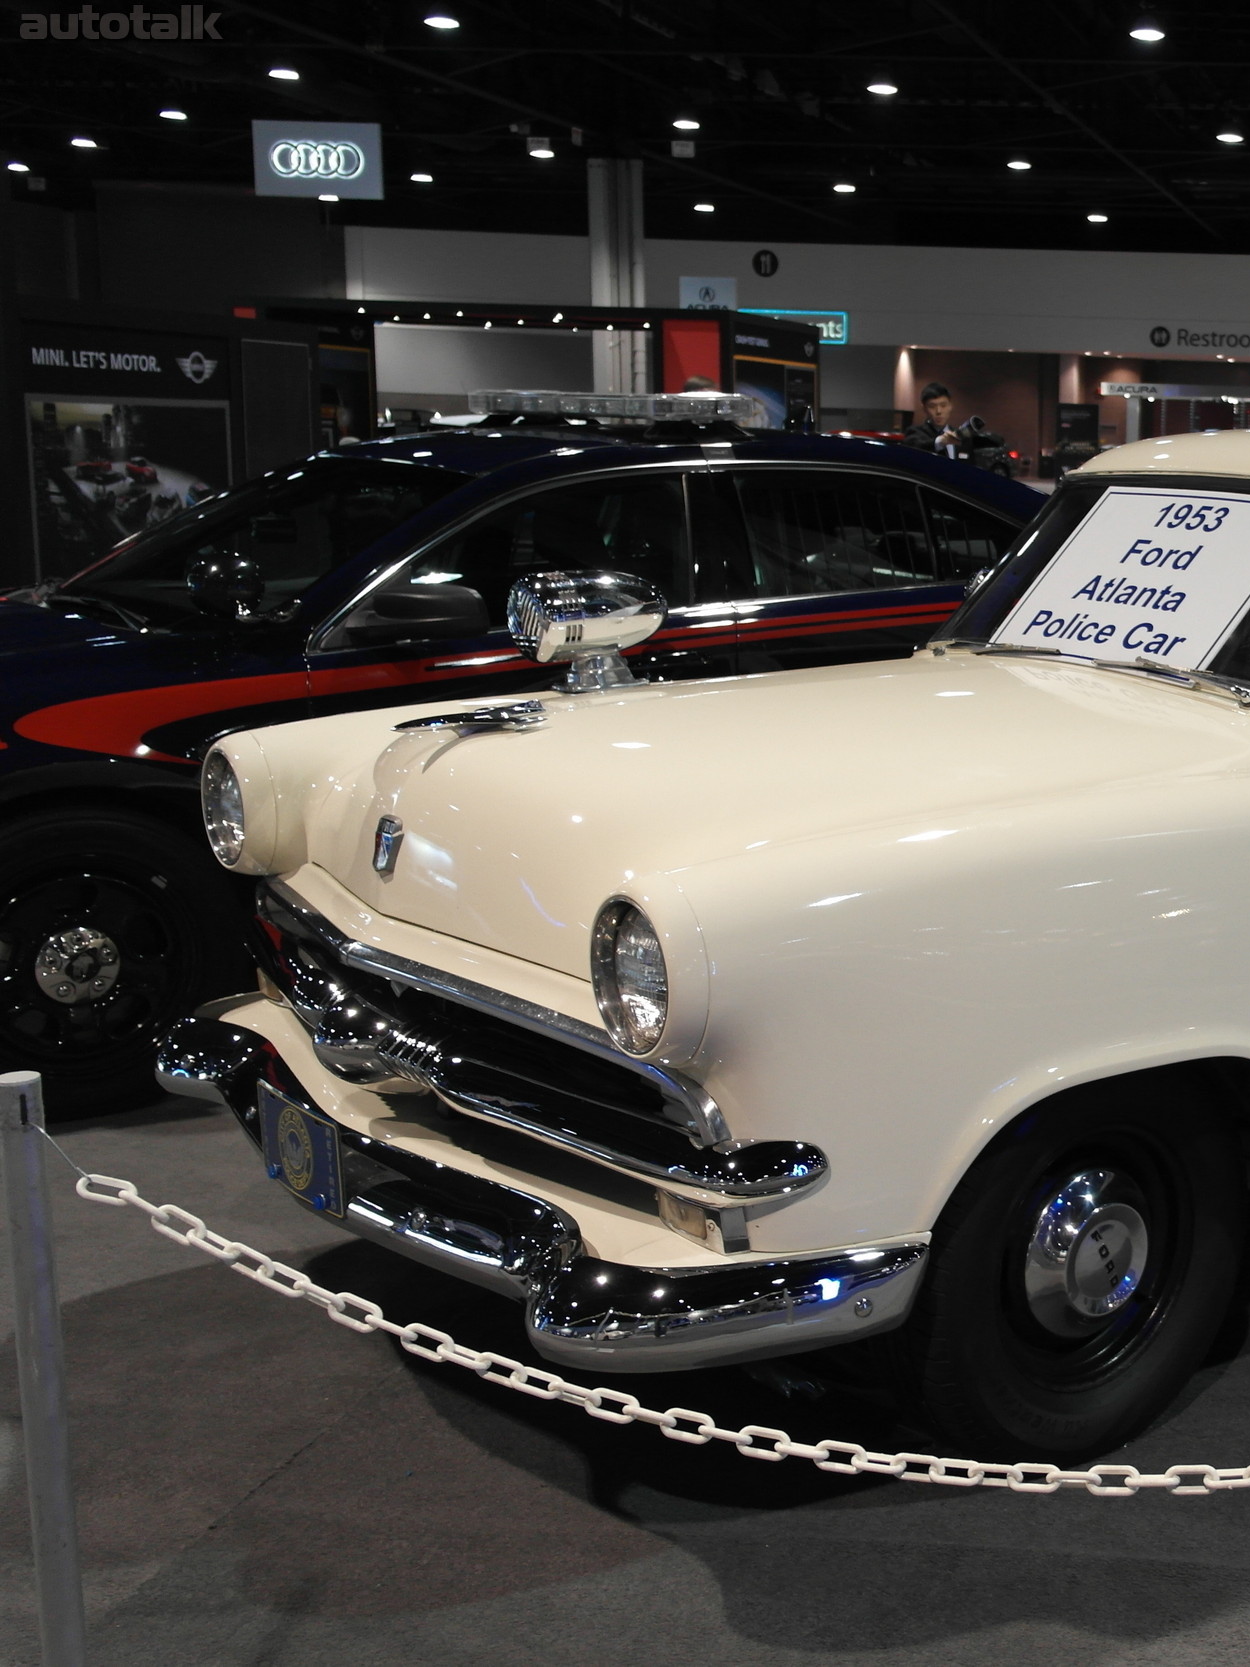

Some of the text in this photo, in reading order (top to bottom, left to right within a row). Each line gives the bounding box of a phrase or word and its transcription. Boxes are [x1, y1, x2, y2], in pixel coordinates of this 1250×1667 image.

[31, 347, 162, 373] MINI. LET'S MOTOR.
[1117, 385, 1158, 394] ACURA
[1154, 502, 1230, 533] 1953
[1119, 539, 1204, 571] Ford
[1071, 575, 1187, 612] Atlanta
[1022, 610, 1186, 657] Police Car
[325, 1127, 337, 1210] RETIRED
[1090, 1229, 1120, 1289] FORD
